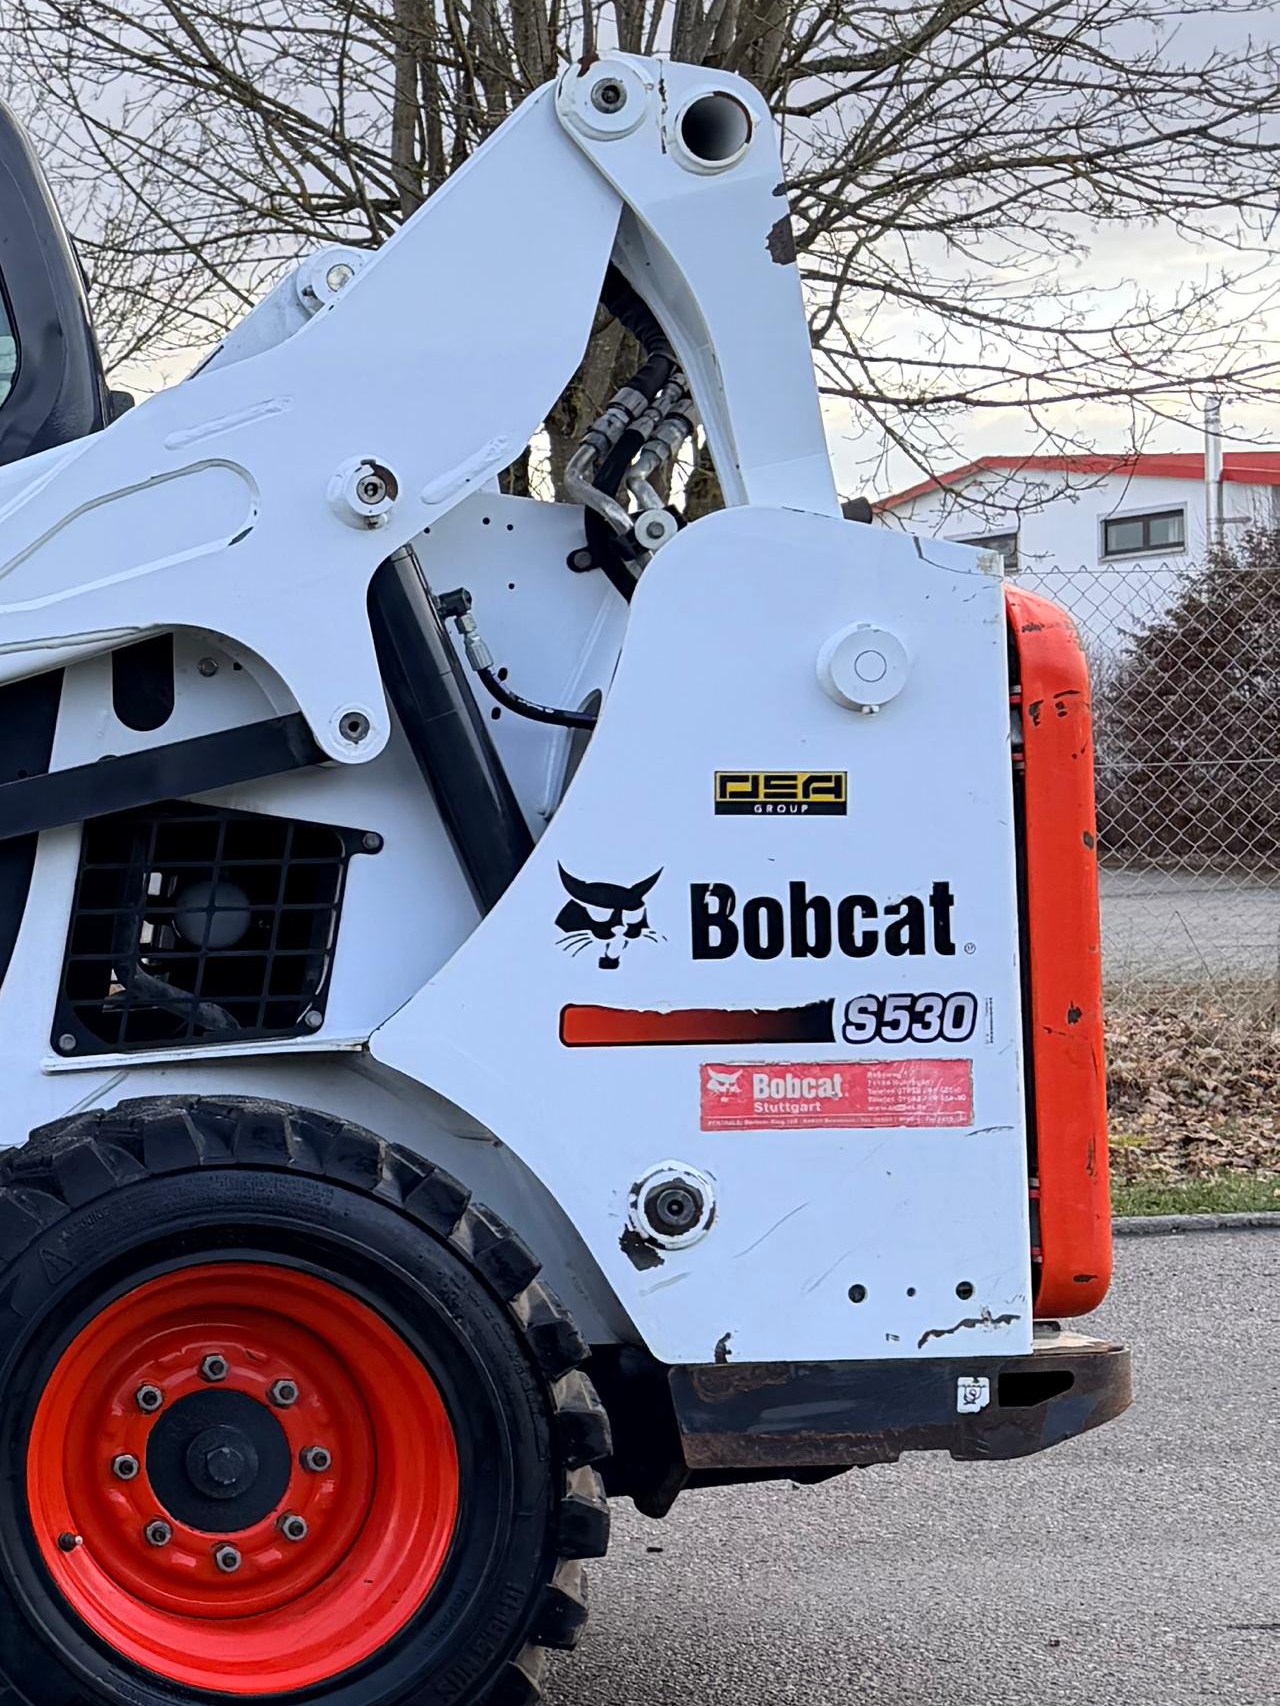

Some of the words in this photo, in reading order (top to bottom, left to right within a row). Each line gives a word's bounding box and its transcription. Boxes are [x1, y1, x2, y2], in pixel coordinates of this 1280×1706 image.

[753, 803, 809, 814] GROUP
[689, 880, 957, 961] Bobcat
[842, 992, 978, 1043] S530
[752, 1072, 843, 1100] Bobcat
[753, 1100, 822, 1114] Stuttgart
